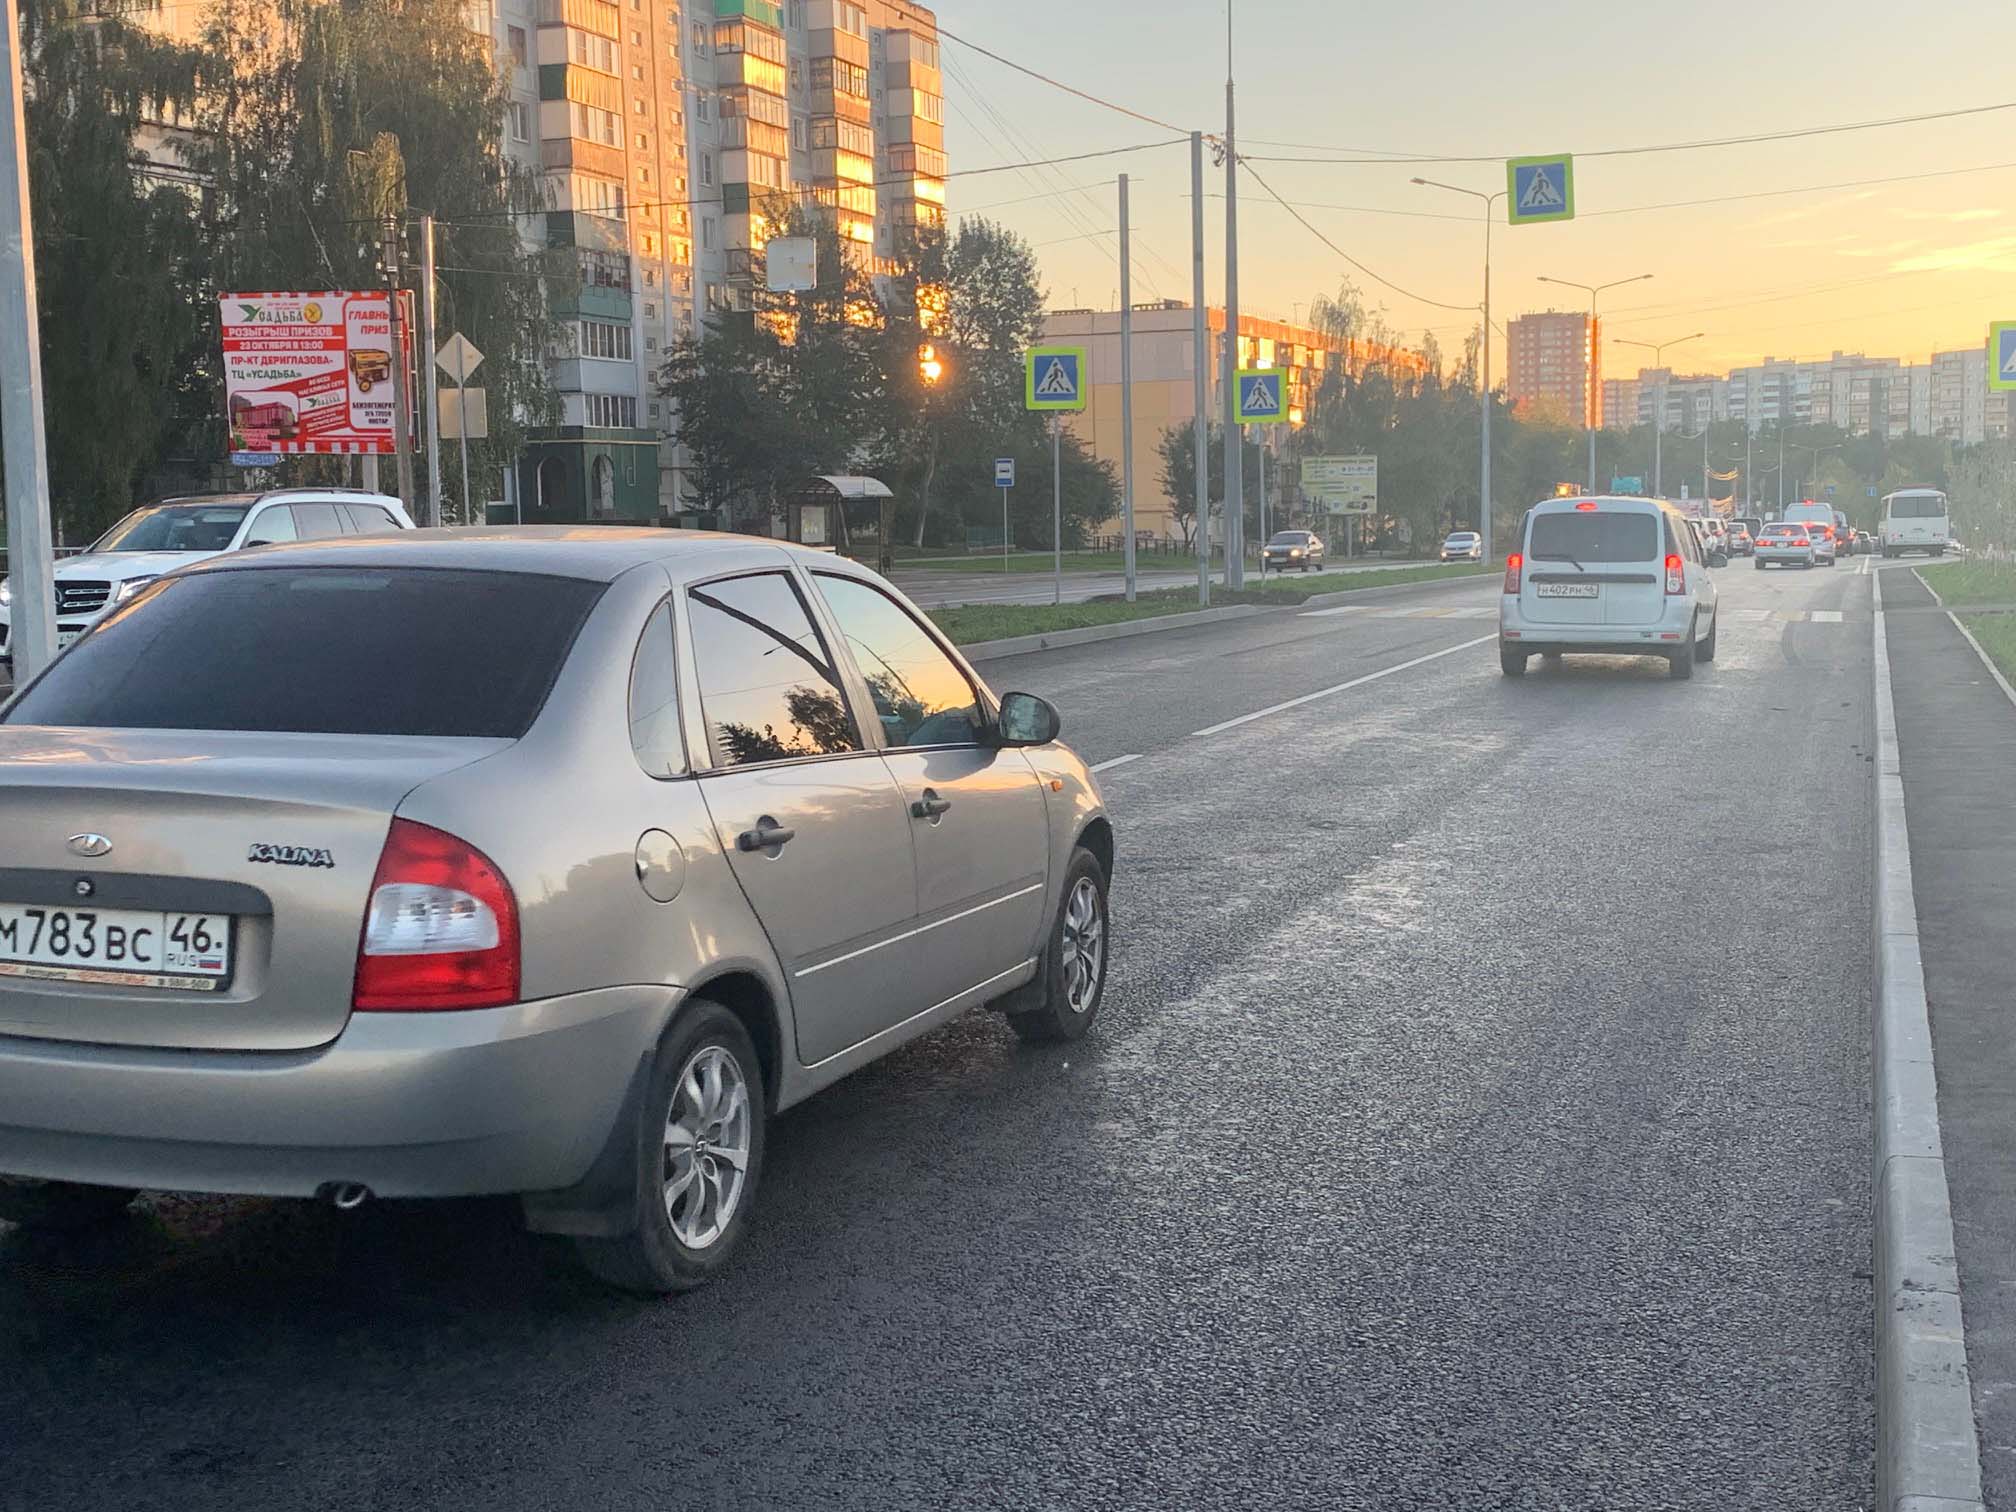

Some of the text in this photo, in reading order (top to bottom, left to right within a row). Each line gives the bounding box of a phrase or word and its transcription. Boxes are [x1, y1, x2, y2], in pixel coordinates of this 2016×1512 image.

[228, 326, 333, 338] РОЗЫГРЫШ ПРИЗОВ
[360, 324, 389, 335] ПРИЗ
[251, 340, 292, 351] ОКТЯБРЯ
[231, 355, 259, 366] ПР-КТ
[231, 369, 245, 380] ТЦ
[248, 843, 335, 869] KALINA
[167, 952, 198, 968] RUS
